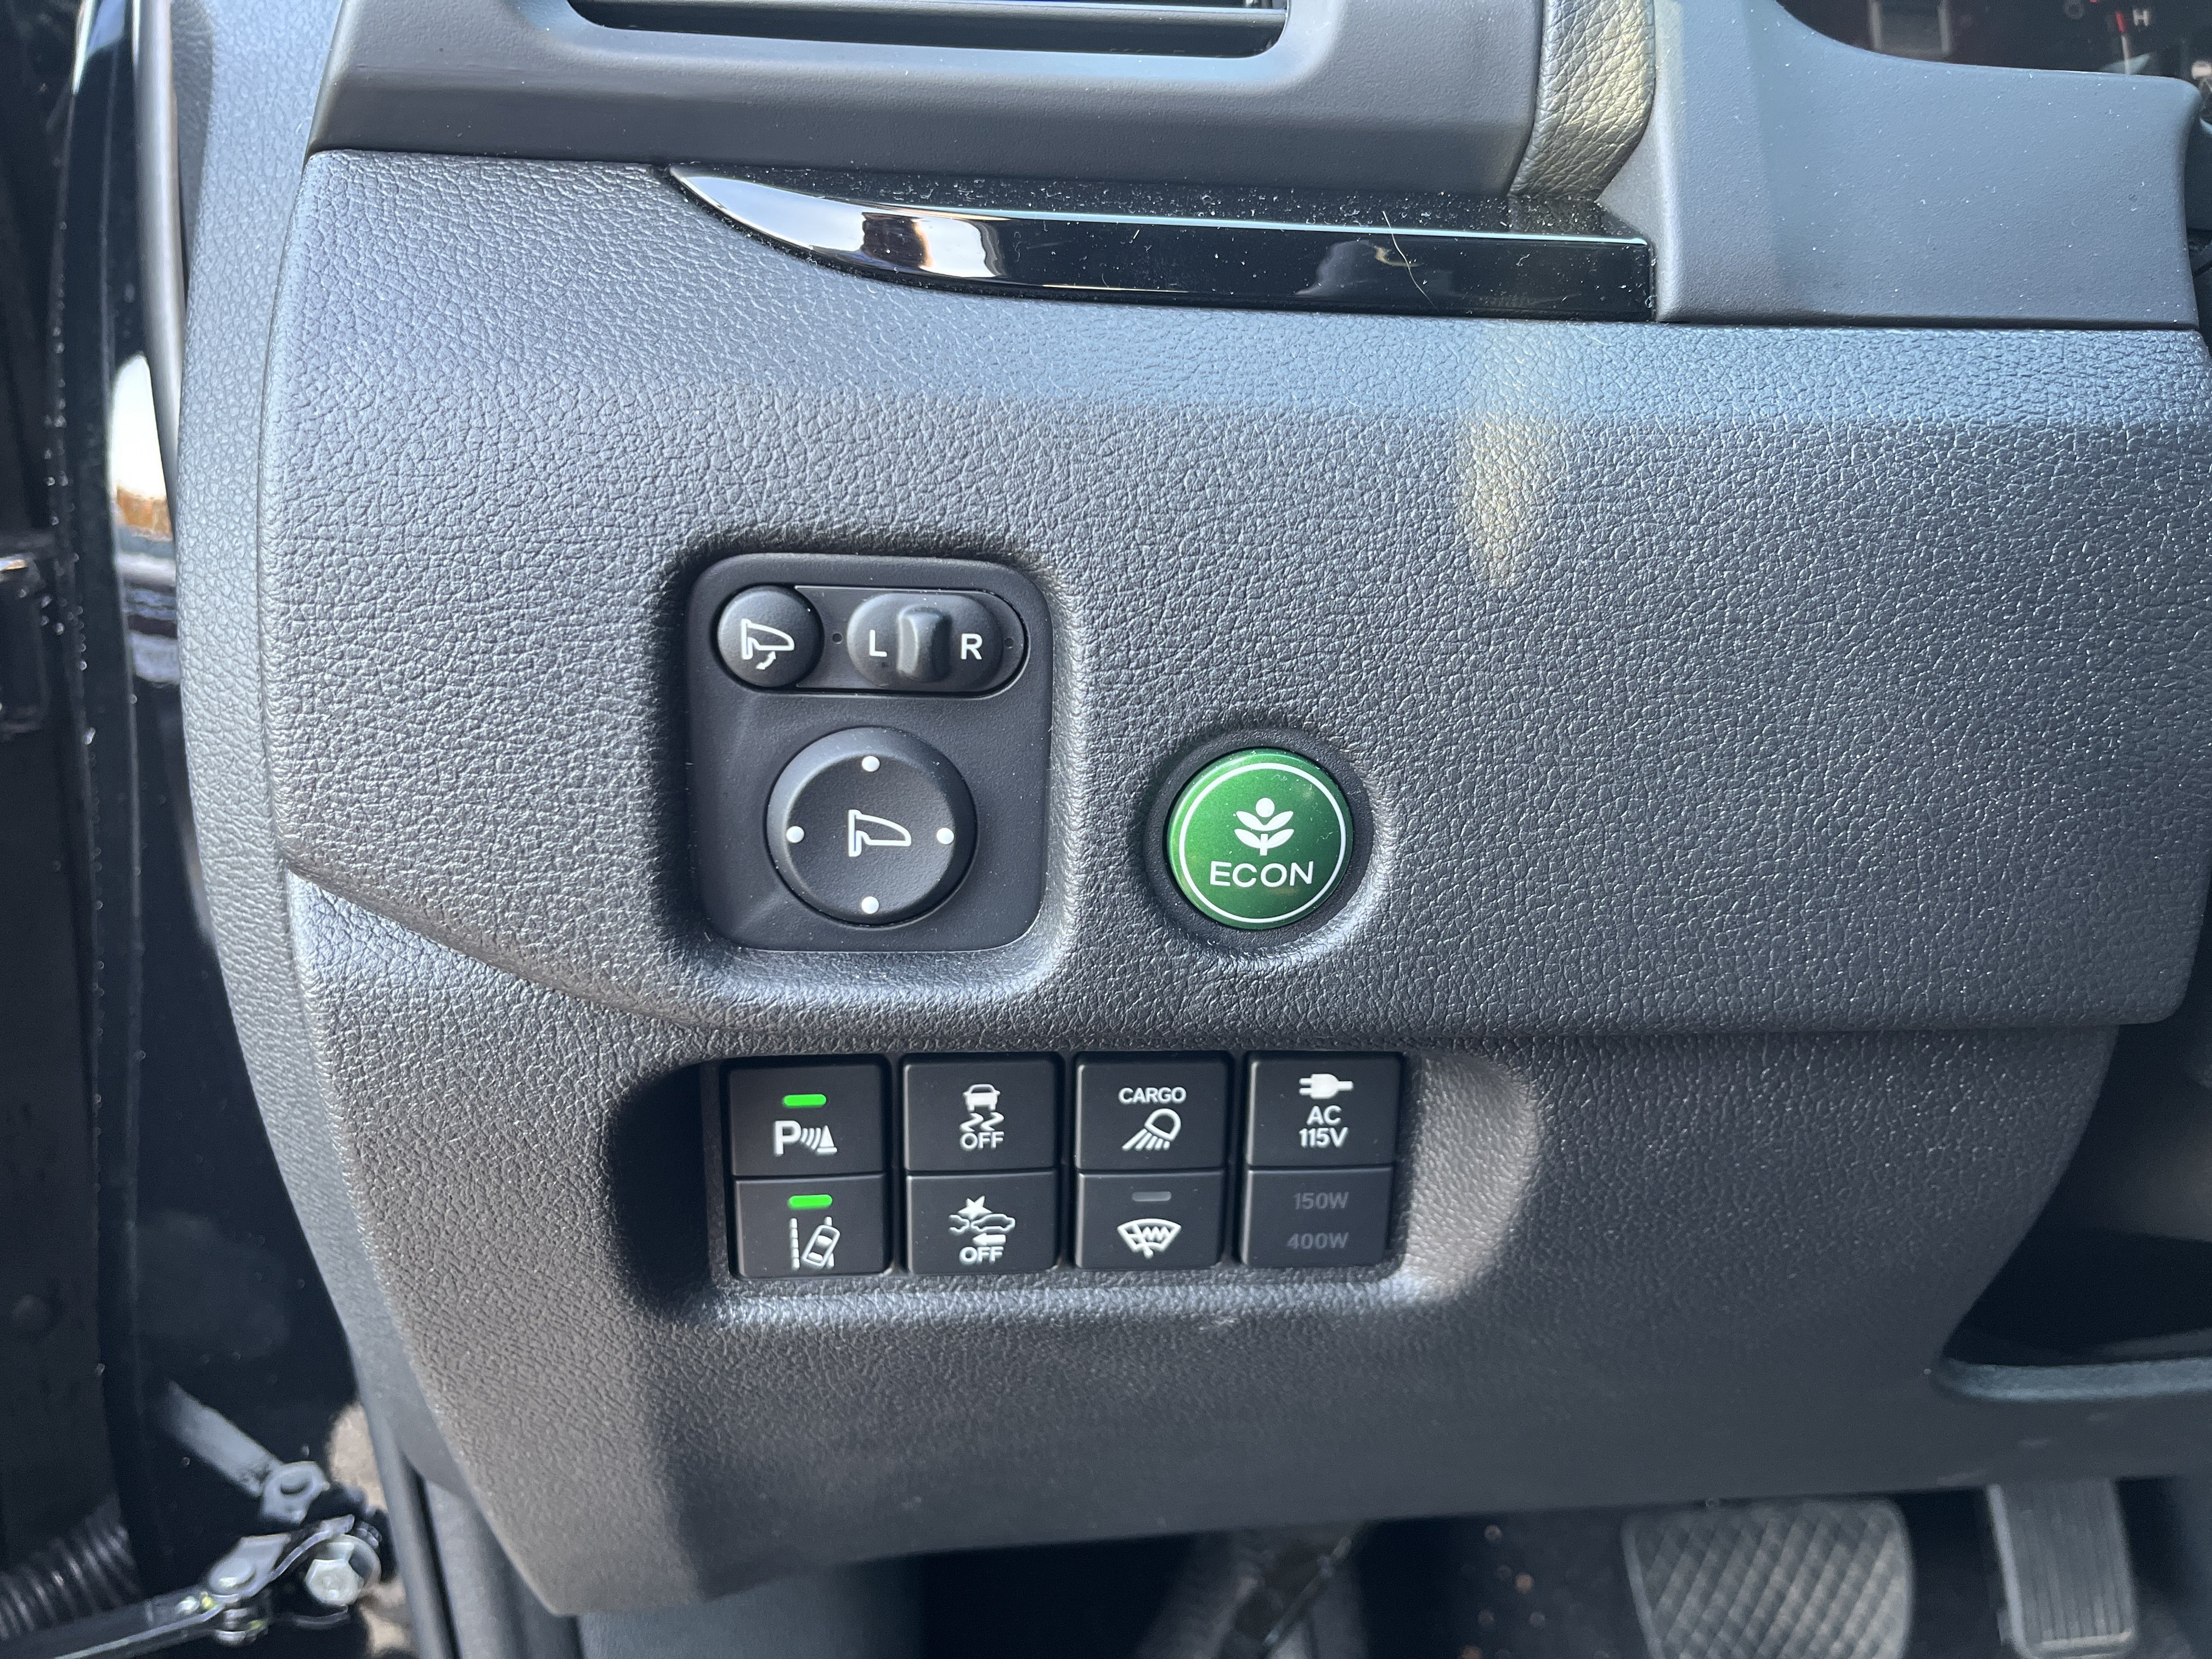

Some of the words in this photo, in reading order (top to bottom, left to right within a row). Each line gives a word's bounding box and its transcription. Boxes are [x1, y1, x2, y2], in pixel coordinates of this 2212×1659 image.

[2133, 9, 2149, 26] H
[869, 629, 887, 657] L
[961, 633, 983, 660] R
[1210, 860, 1314, 888] ECON
[1119, 1087, 1187, 1104] CARGO
[1307, 1105, 1342, 1125] AC
[775, 1120, 802, 1155] P
[960, 1132, 1005, 1150] OFF
[1299, 1127, 1348, 1147] 115V
[1295, 1192, 1348, 1210] 150W
[1287, 1232, 1348, 1249] 400W
[960, 1246, 1005, 1264] OFF
